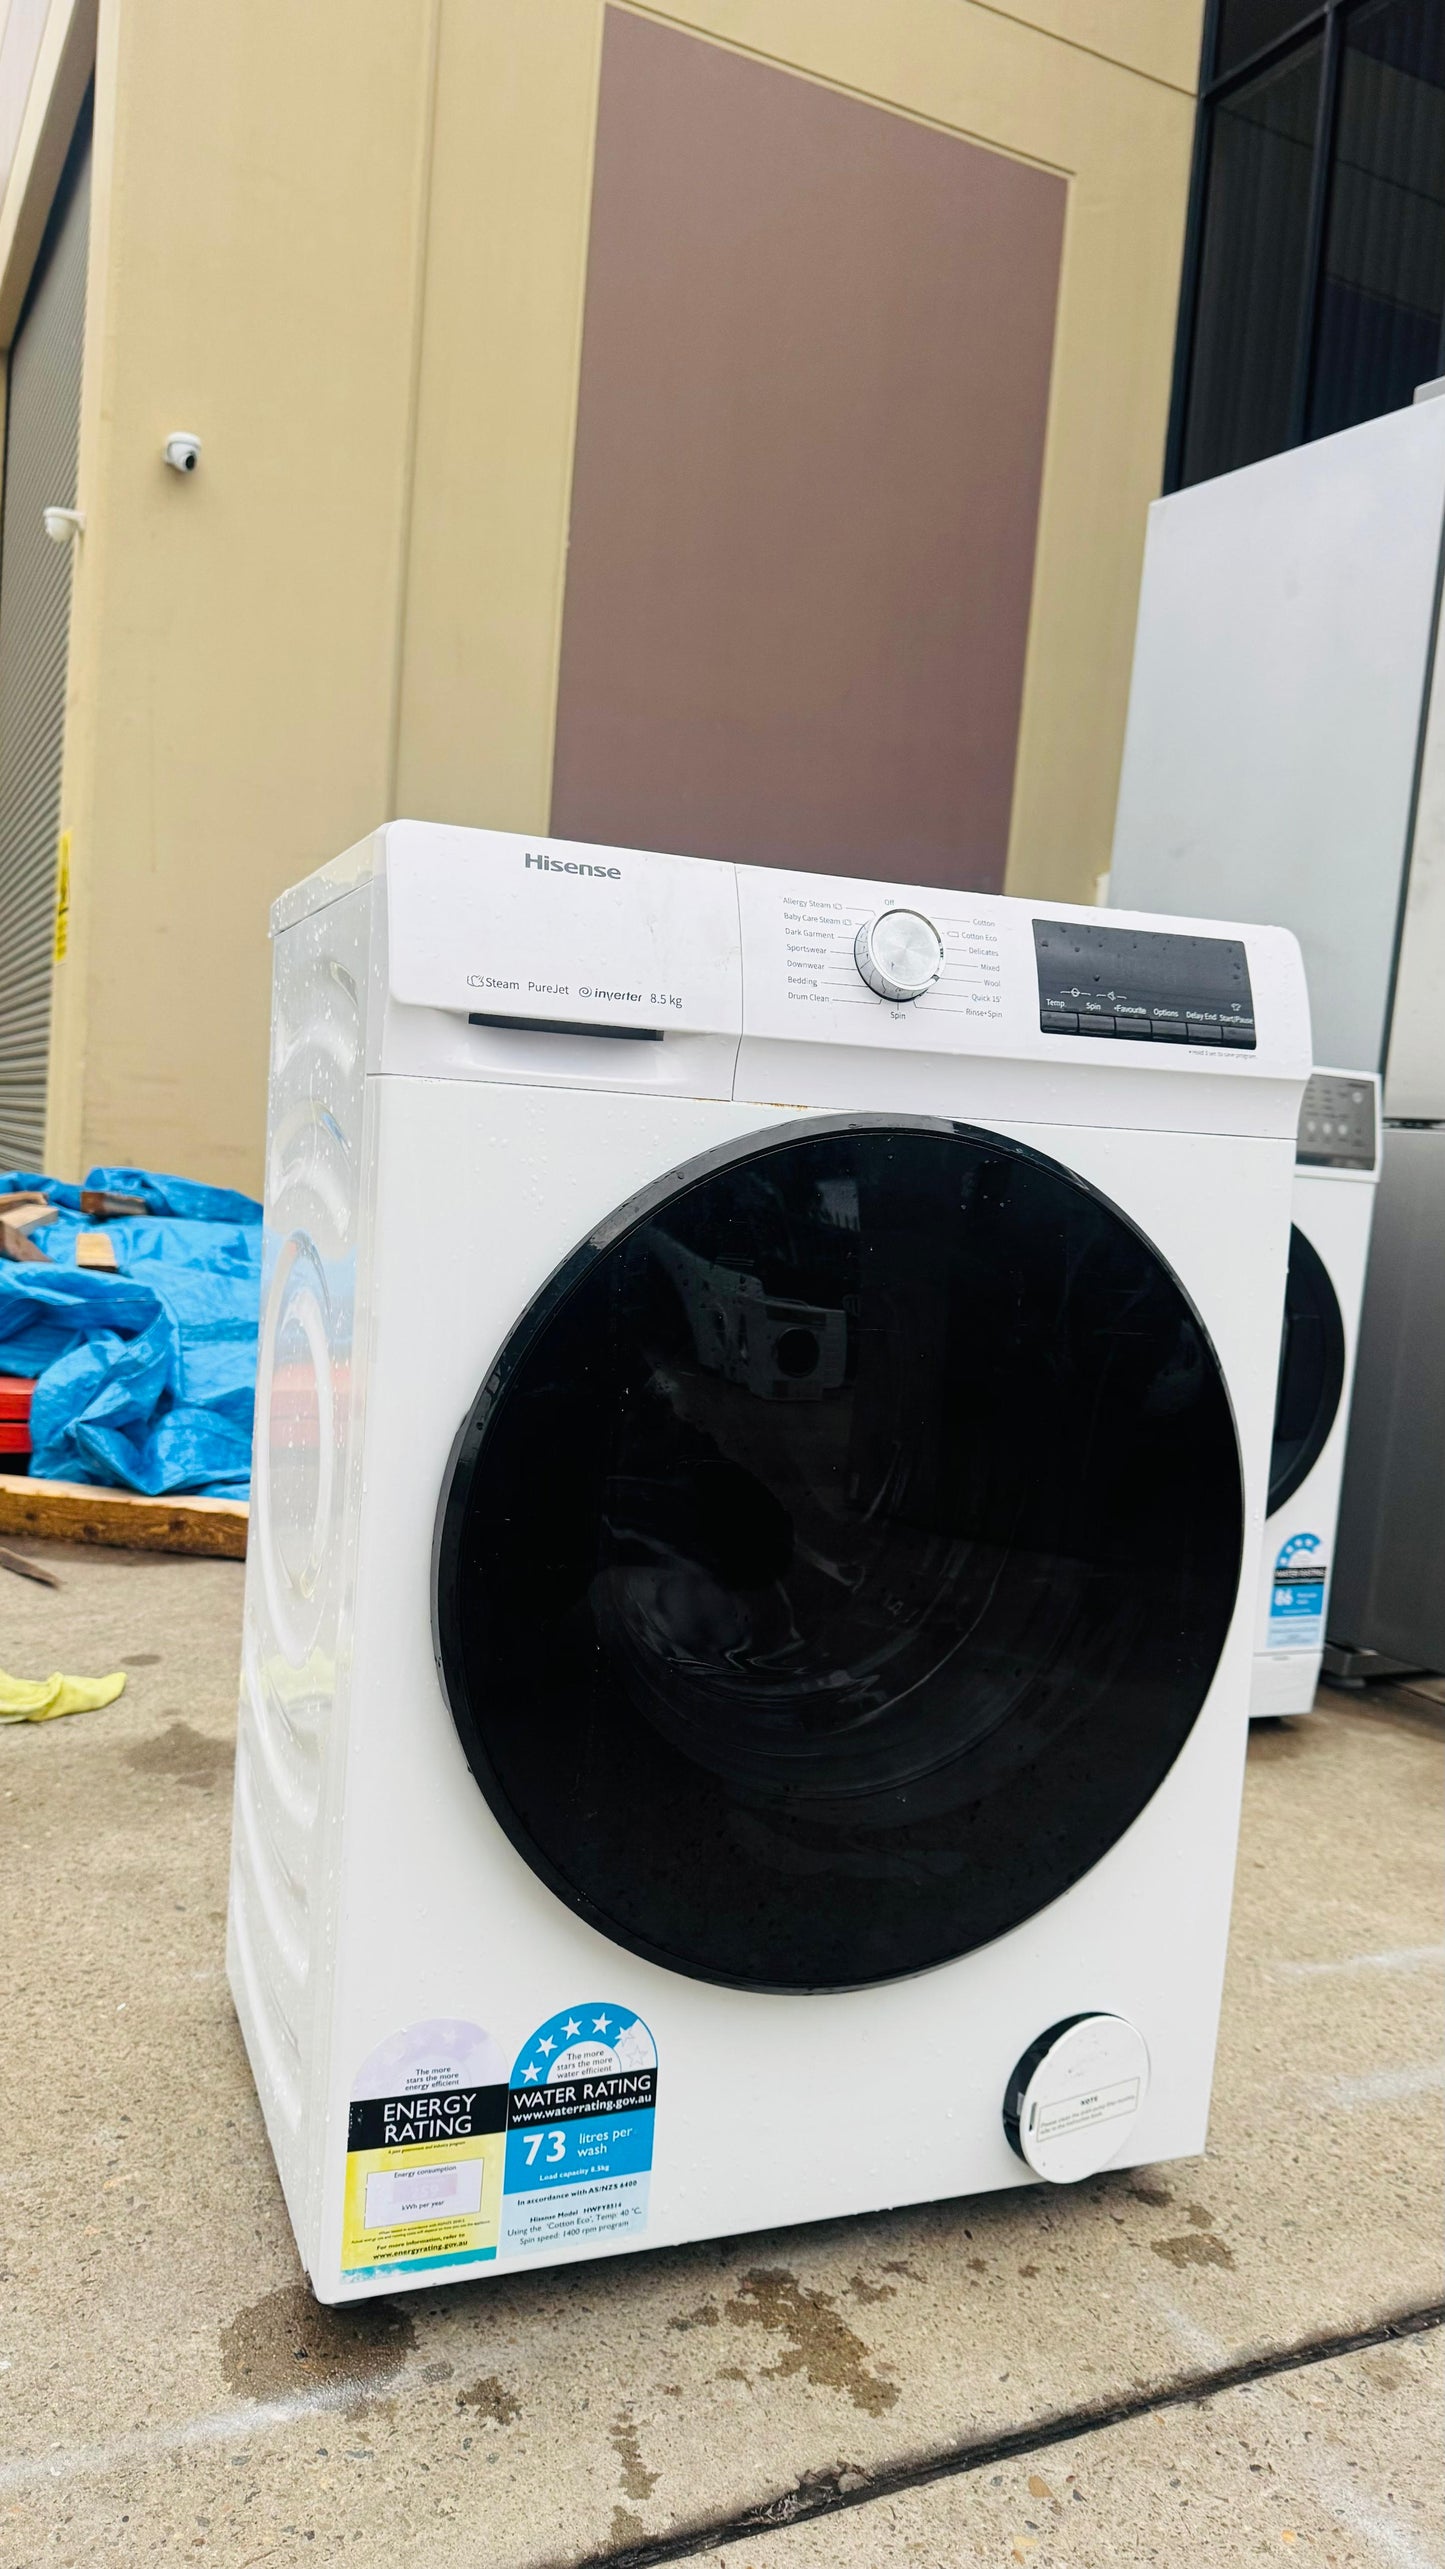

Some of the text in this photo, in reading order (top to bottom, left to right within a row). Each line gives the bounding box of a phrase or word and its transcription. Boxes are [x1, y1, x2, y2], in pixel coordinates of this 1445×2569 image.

[525, 853, 621, 880] Hisense
[783, 898, 832, 909] Allergy Steam
[784, 912, 841, 925] Baby Care Steam
[973, 919, 995, 927] Cotton
[785, 928, 835, 940] Dark Garment
[962, 932, 984, 940] Cotton
[786, 944, 827, 954] Sportswear
[969, 947, 999, 957] Delicates
[787, 960, 825, 970] Downwear
[981, 964, 1000, 972] Mixed
[788, 976, 818, 987] Bedding
[984, 979, 1001, 987] Wool
[486, 978, 683, 1009] Steam PureJet inverter 8.5 kg
[788, 992, 830, 1003] Drum Clean
[972, 994, 990, 1002] Quick
[1086, 1002, 1102, 1011] Spin
[890, 1012, 906, 1021] Spin
[1154, 1008, 1179, 1017] Options
[1186, 1012, 1217, 1021] Delay End
[568, 2050, 605, 2061] The more
[557, 2057, 613, 2071] stars the more
[557, 2066, 612, 2079] water efficient
[432, 2080, 459, 2088] efficient
[514, 2075, 651, 2110] WATER RATING
[384, 2094, 477, 2122] ENERGY
[512, 2094, 652, 2123] www.waterrating.gov.au
[385, 2116, 472, 2144] RATING
[523, 2128, 633, 2166] 73 litres per
[578, 2144, 607, 2157] wash
[417, 2165, 457, 2176] consumption
[540, 2173, 558, 2182] Load
[560, 2168, 589, 2179] capacity
[527, 2192, 569, 2205] accordance
[419, 2202, 429, 2210] per
[432, 2200, 445, 2208] year
[558, 2210, 579, 2219] Model
[507, 2228, 528, 2237] Using
[620, 2208, 630, 2217] 40
[520, 2238, 535, 2246] Spin
[562, 2228, 580, 2238] 1400
[582, 2226, 597, 2235] rpm
[598, 2220, 629, 2232] program
